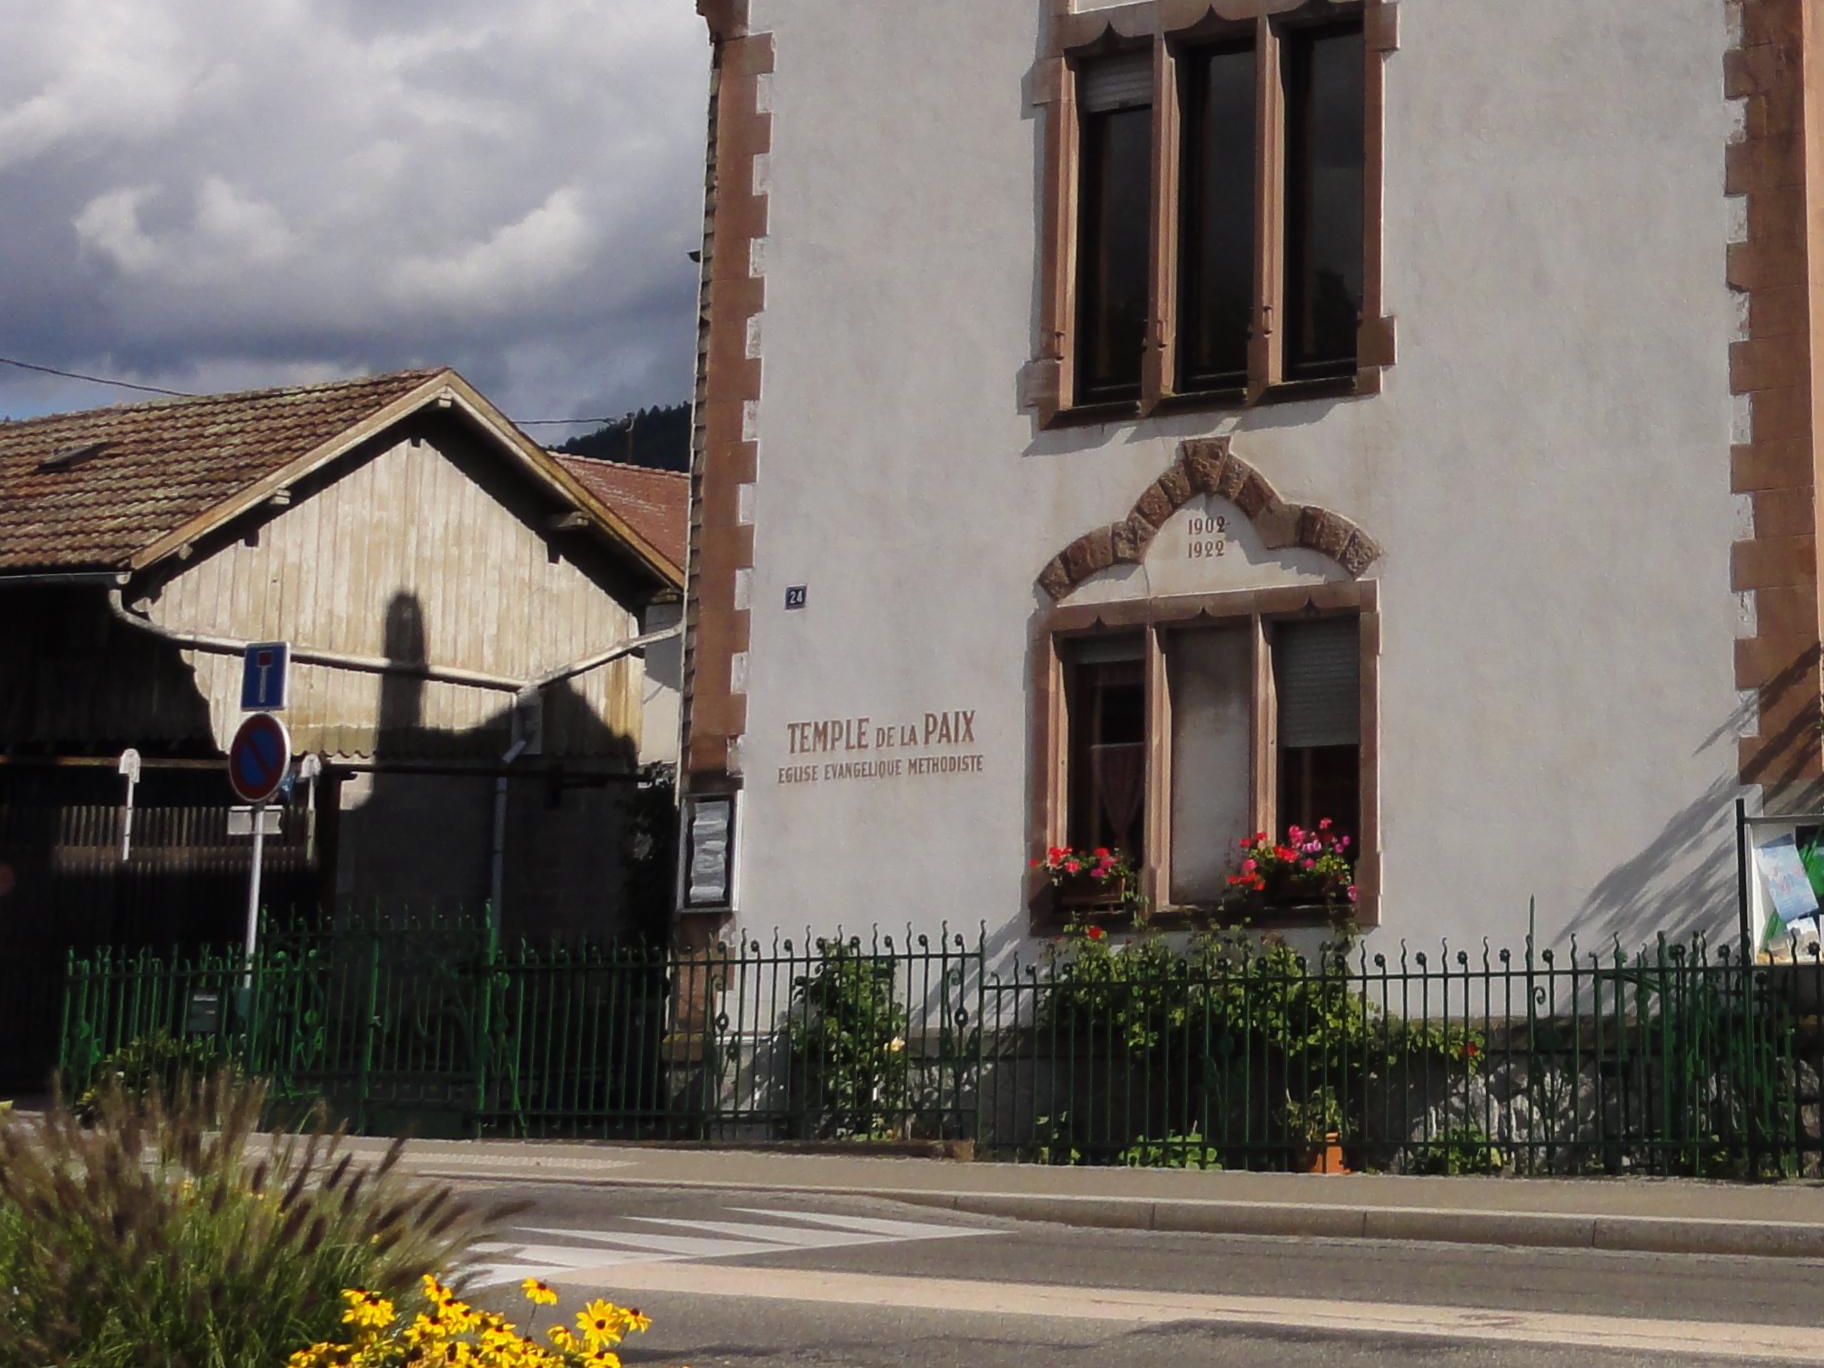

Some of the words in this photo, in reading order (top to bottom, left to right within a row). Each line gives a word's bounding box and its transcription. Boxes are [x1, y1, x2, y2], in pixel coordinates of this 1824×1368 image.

[1188, 540, 1225, 559] 1922
[787, 718, 870, 753] TEMPLE
[876, 727, 895, 748] DE
[900, 725, 918, 746] LA
[923, 710, 976, 745] PAIX
[778, 765, 819, 783] EGLISE
[824, 759, 902, 779] EVANGELIQUE
[908, 755, 984, 775] METHODISTE
